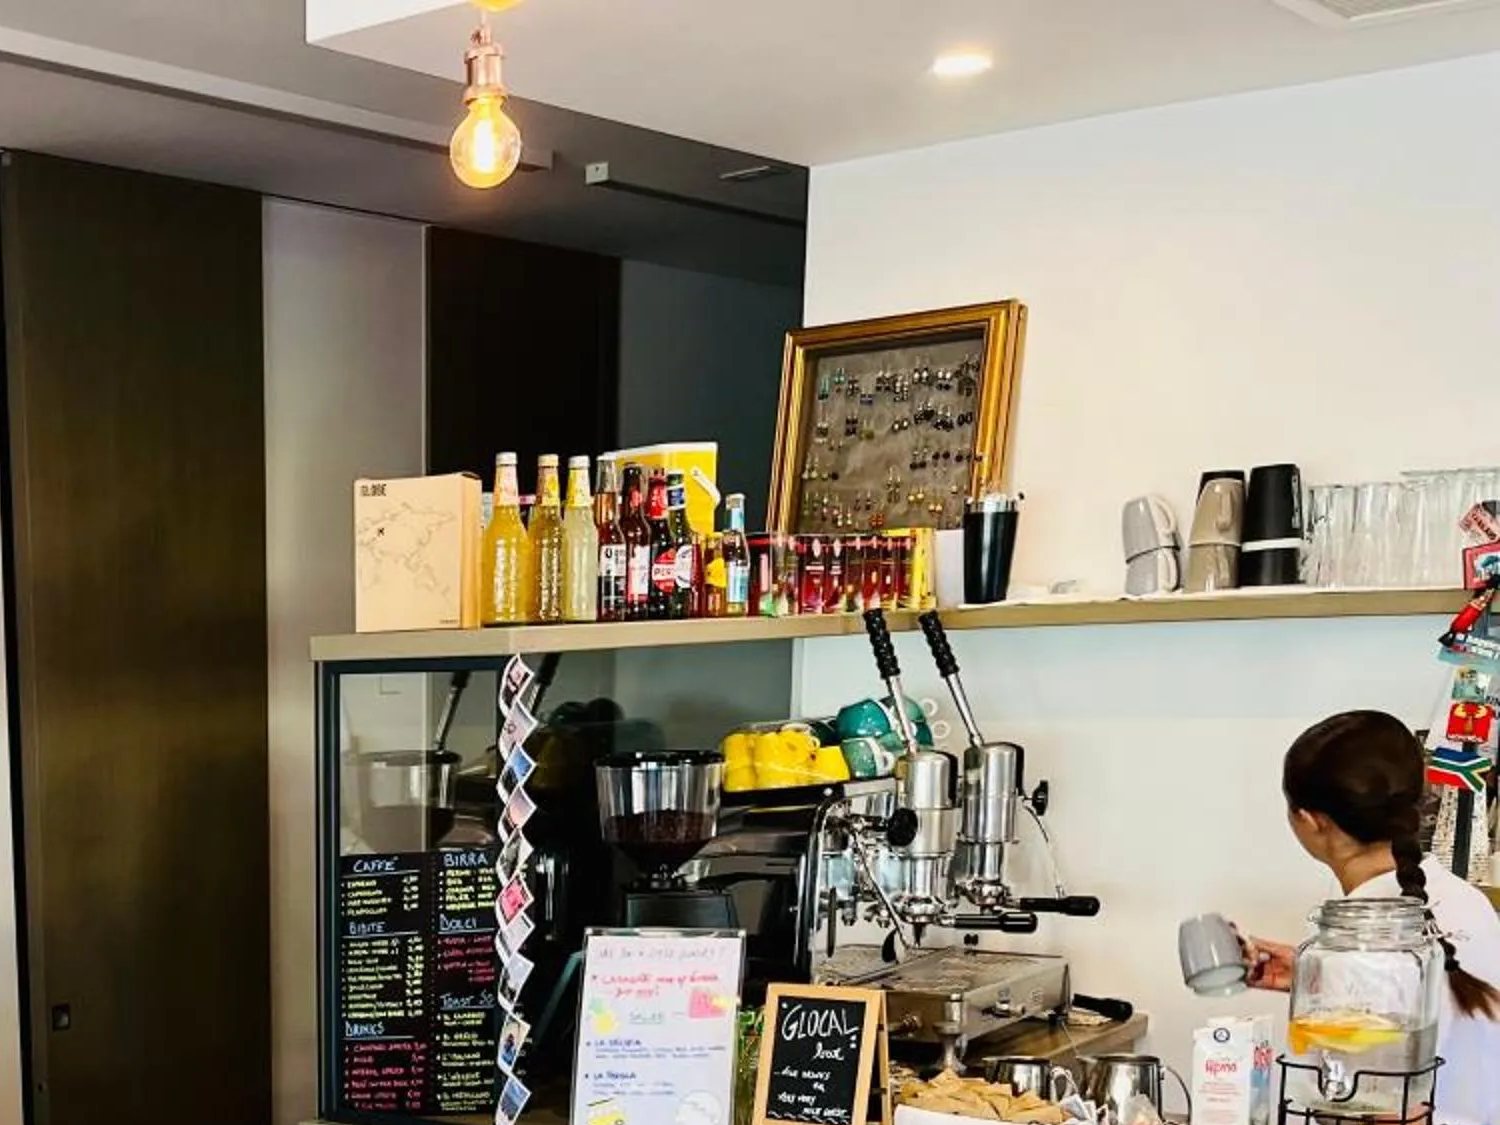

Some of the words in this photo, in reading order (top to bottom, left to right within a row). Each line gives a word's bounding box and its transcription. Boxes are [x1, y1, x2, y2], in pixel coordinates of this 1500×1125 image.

[443, 853, 489, 868] BIRRA
[438, 916, 478, 931] DOLCI
[344, 1021, 385, 1036] DRINKS
[781, 1003, 860, 1041] GLOCAL
